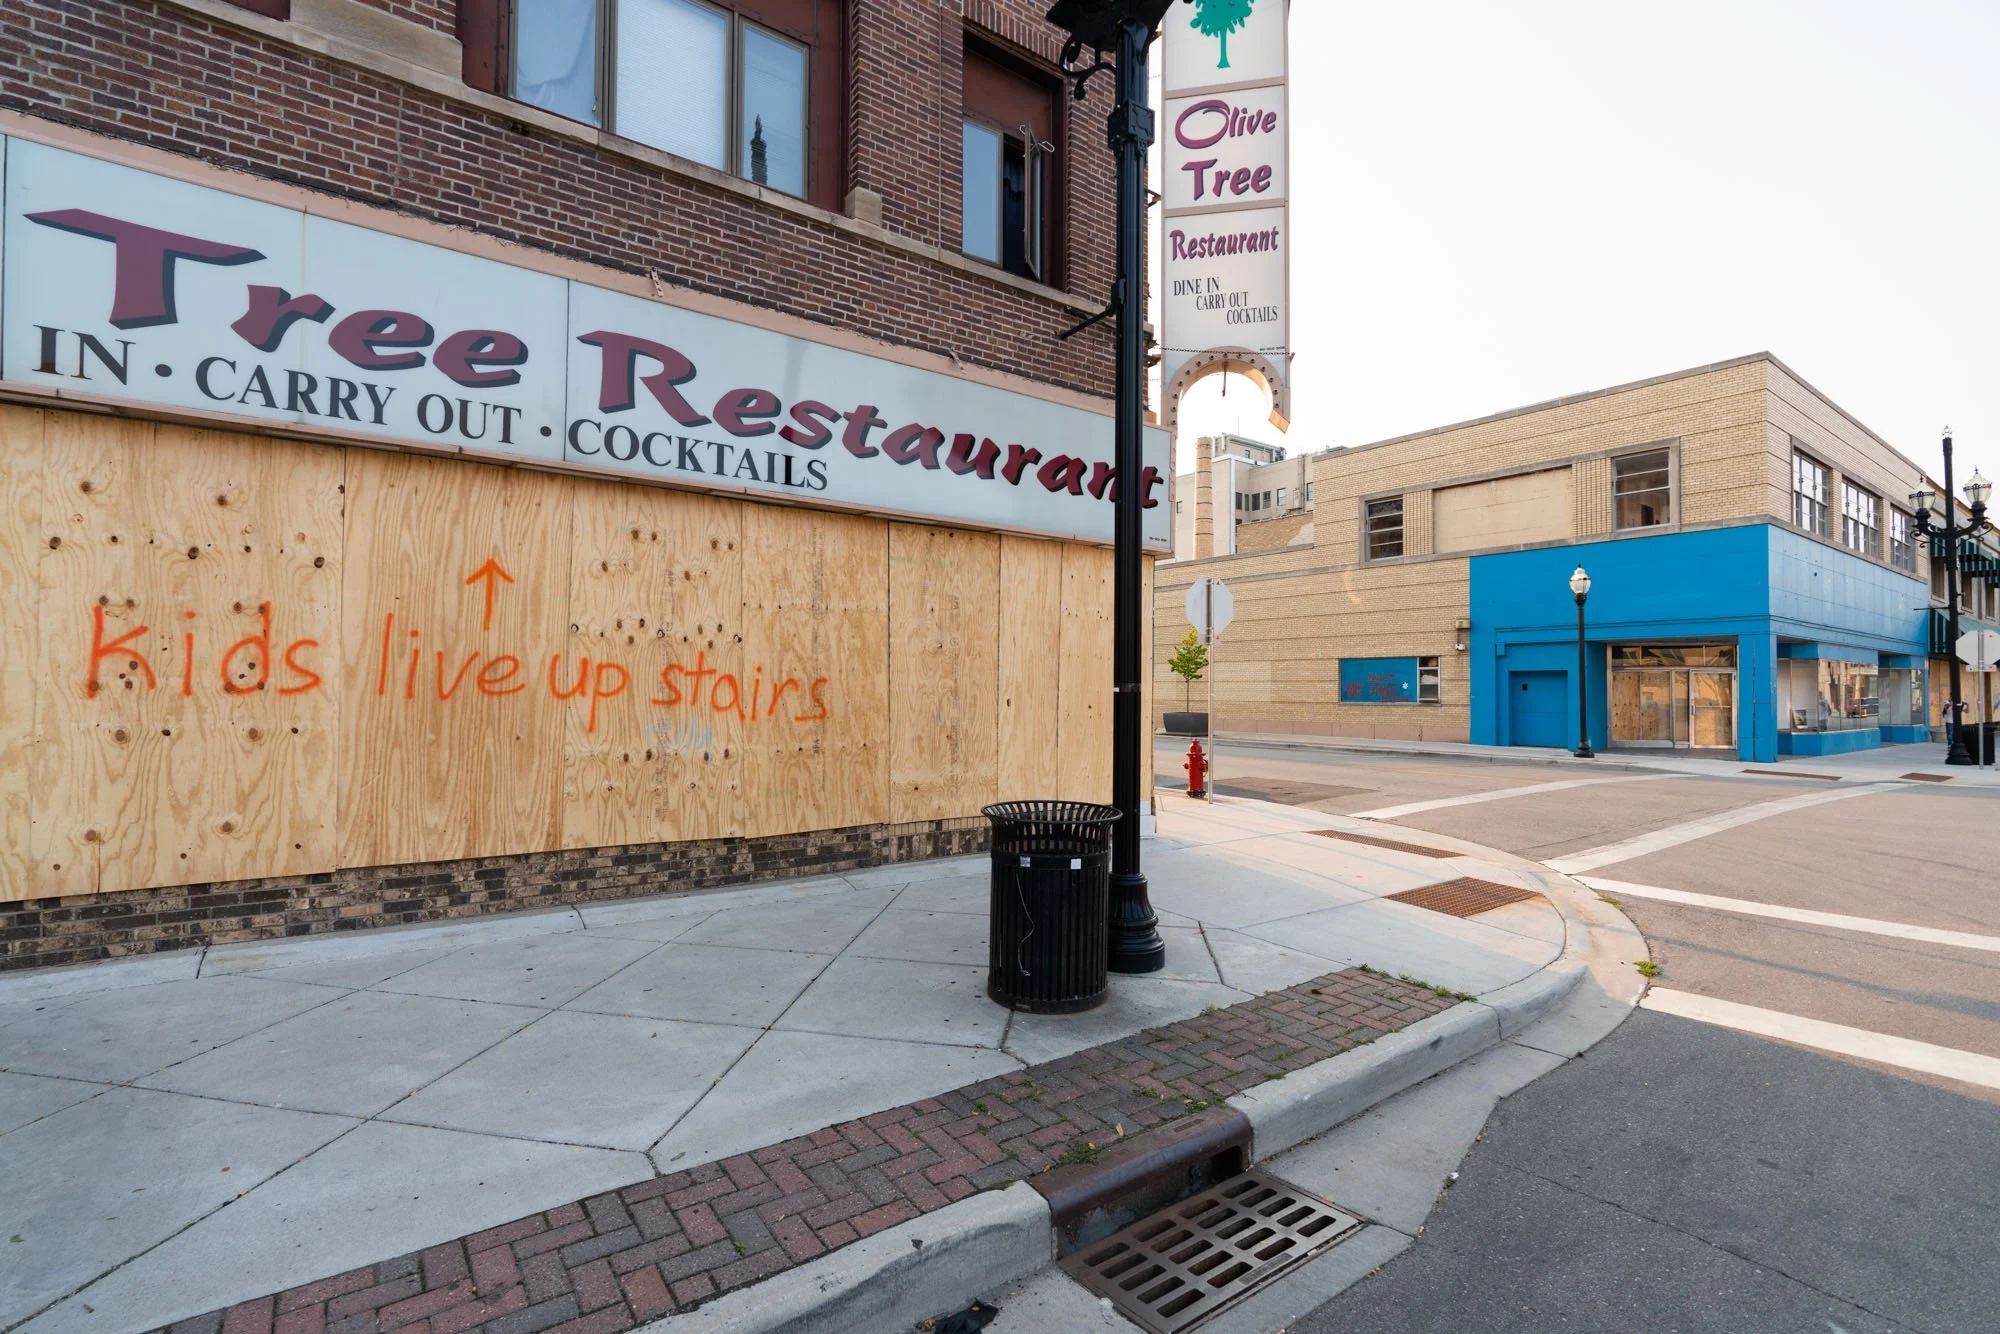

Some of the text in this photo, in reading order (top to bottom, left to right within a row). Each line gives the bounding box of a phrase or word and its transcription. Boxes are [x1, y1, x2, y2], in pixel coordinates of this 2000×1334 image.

[1174, 99, 1277, 149] Olive
[1181, 158, 1272, 201] Tree
[1169, 226, 1279, 261] Restaurant
[1173, 277, 1220, 296] DINE IN
[1196, 292, 1248, 310] CARRY OUT
[1226, 306, 1278, 325] COCKTAILS
[24, 208, 1165, 508] Tree Restaurant
[32, 325, 829, 491] IN CARRY OUT COCKTAILS
[378, 612, 526, 701] live
[548, 652, 630, 733] up
[650, 650, 828, 722] stairs
